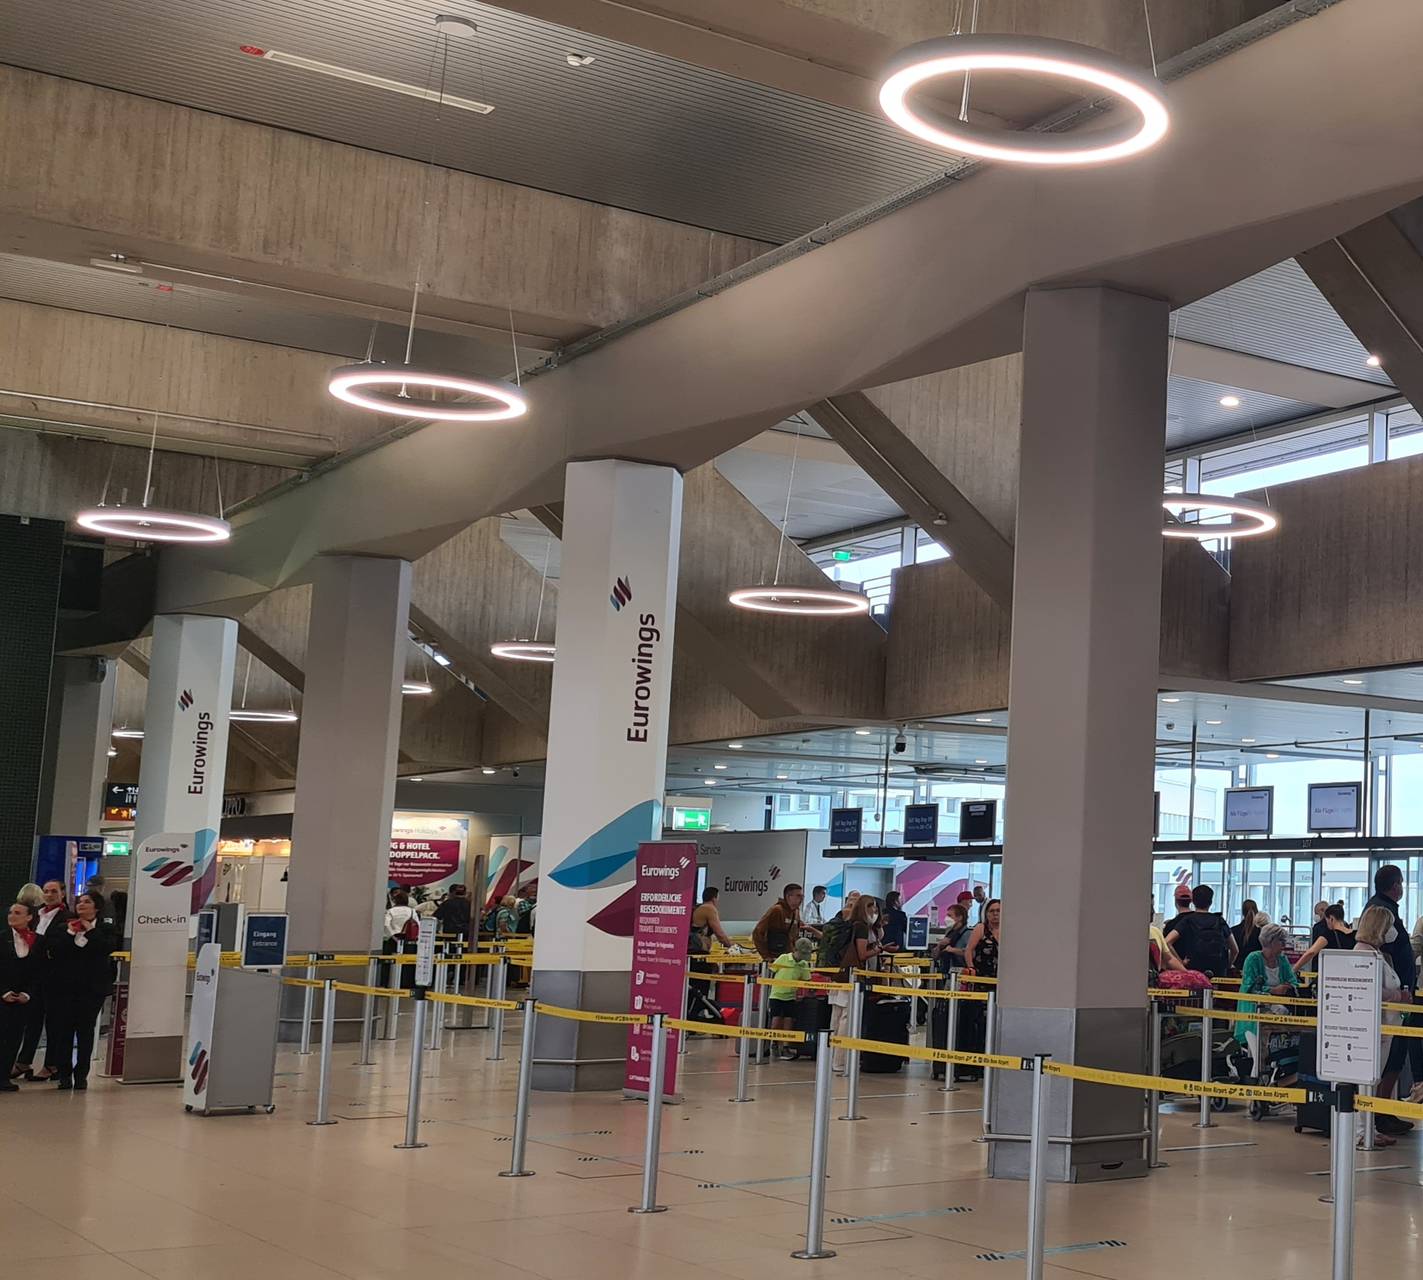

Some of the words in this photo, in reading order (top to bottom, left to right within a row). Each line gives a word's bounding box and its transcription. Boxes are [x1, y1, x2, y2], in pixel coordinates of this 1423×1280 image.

[627, 613, 660, 742] Eurowings
[188, 712, 214, 794] Eurowings
[701, 844, 721, 855] Service
[641, 865, 680, 879] Eurowings
[725, 876, 768, 896] Eurowings
[641, 893, 682, 902] ERFORDERLICHE
[640, 905, 686, 915] REISEDOKUMENTE
[138, 915, 186, 924] Check-in
